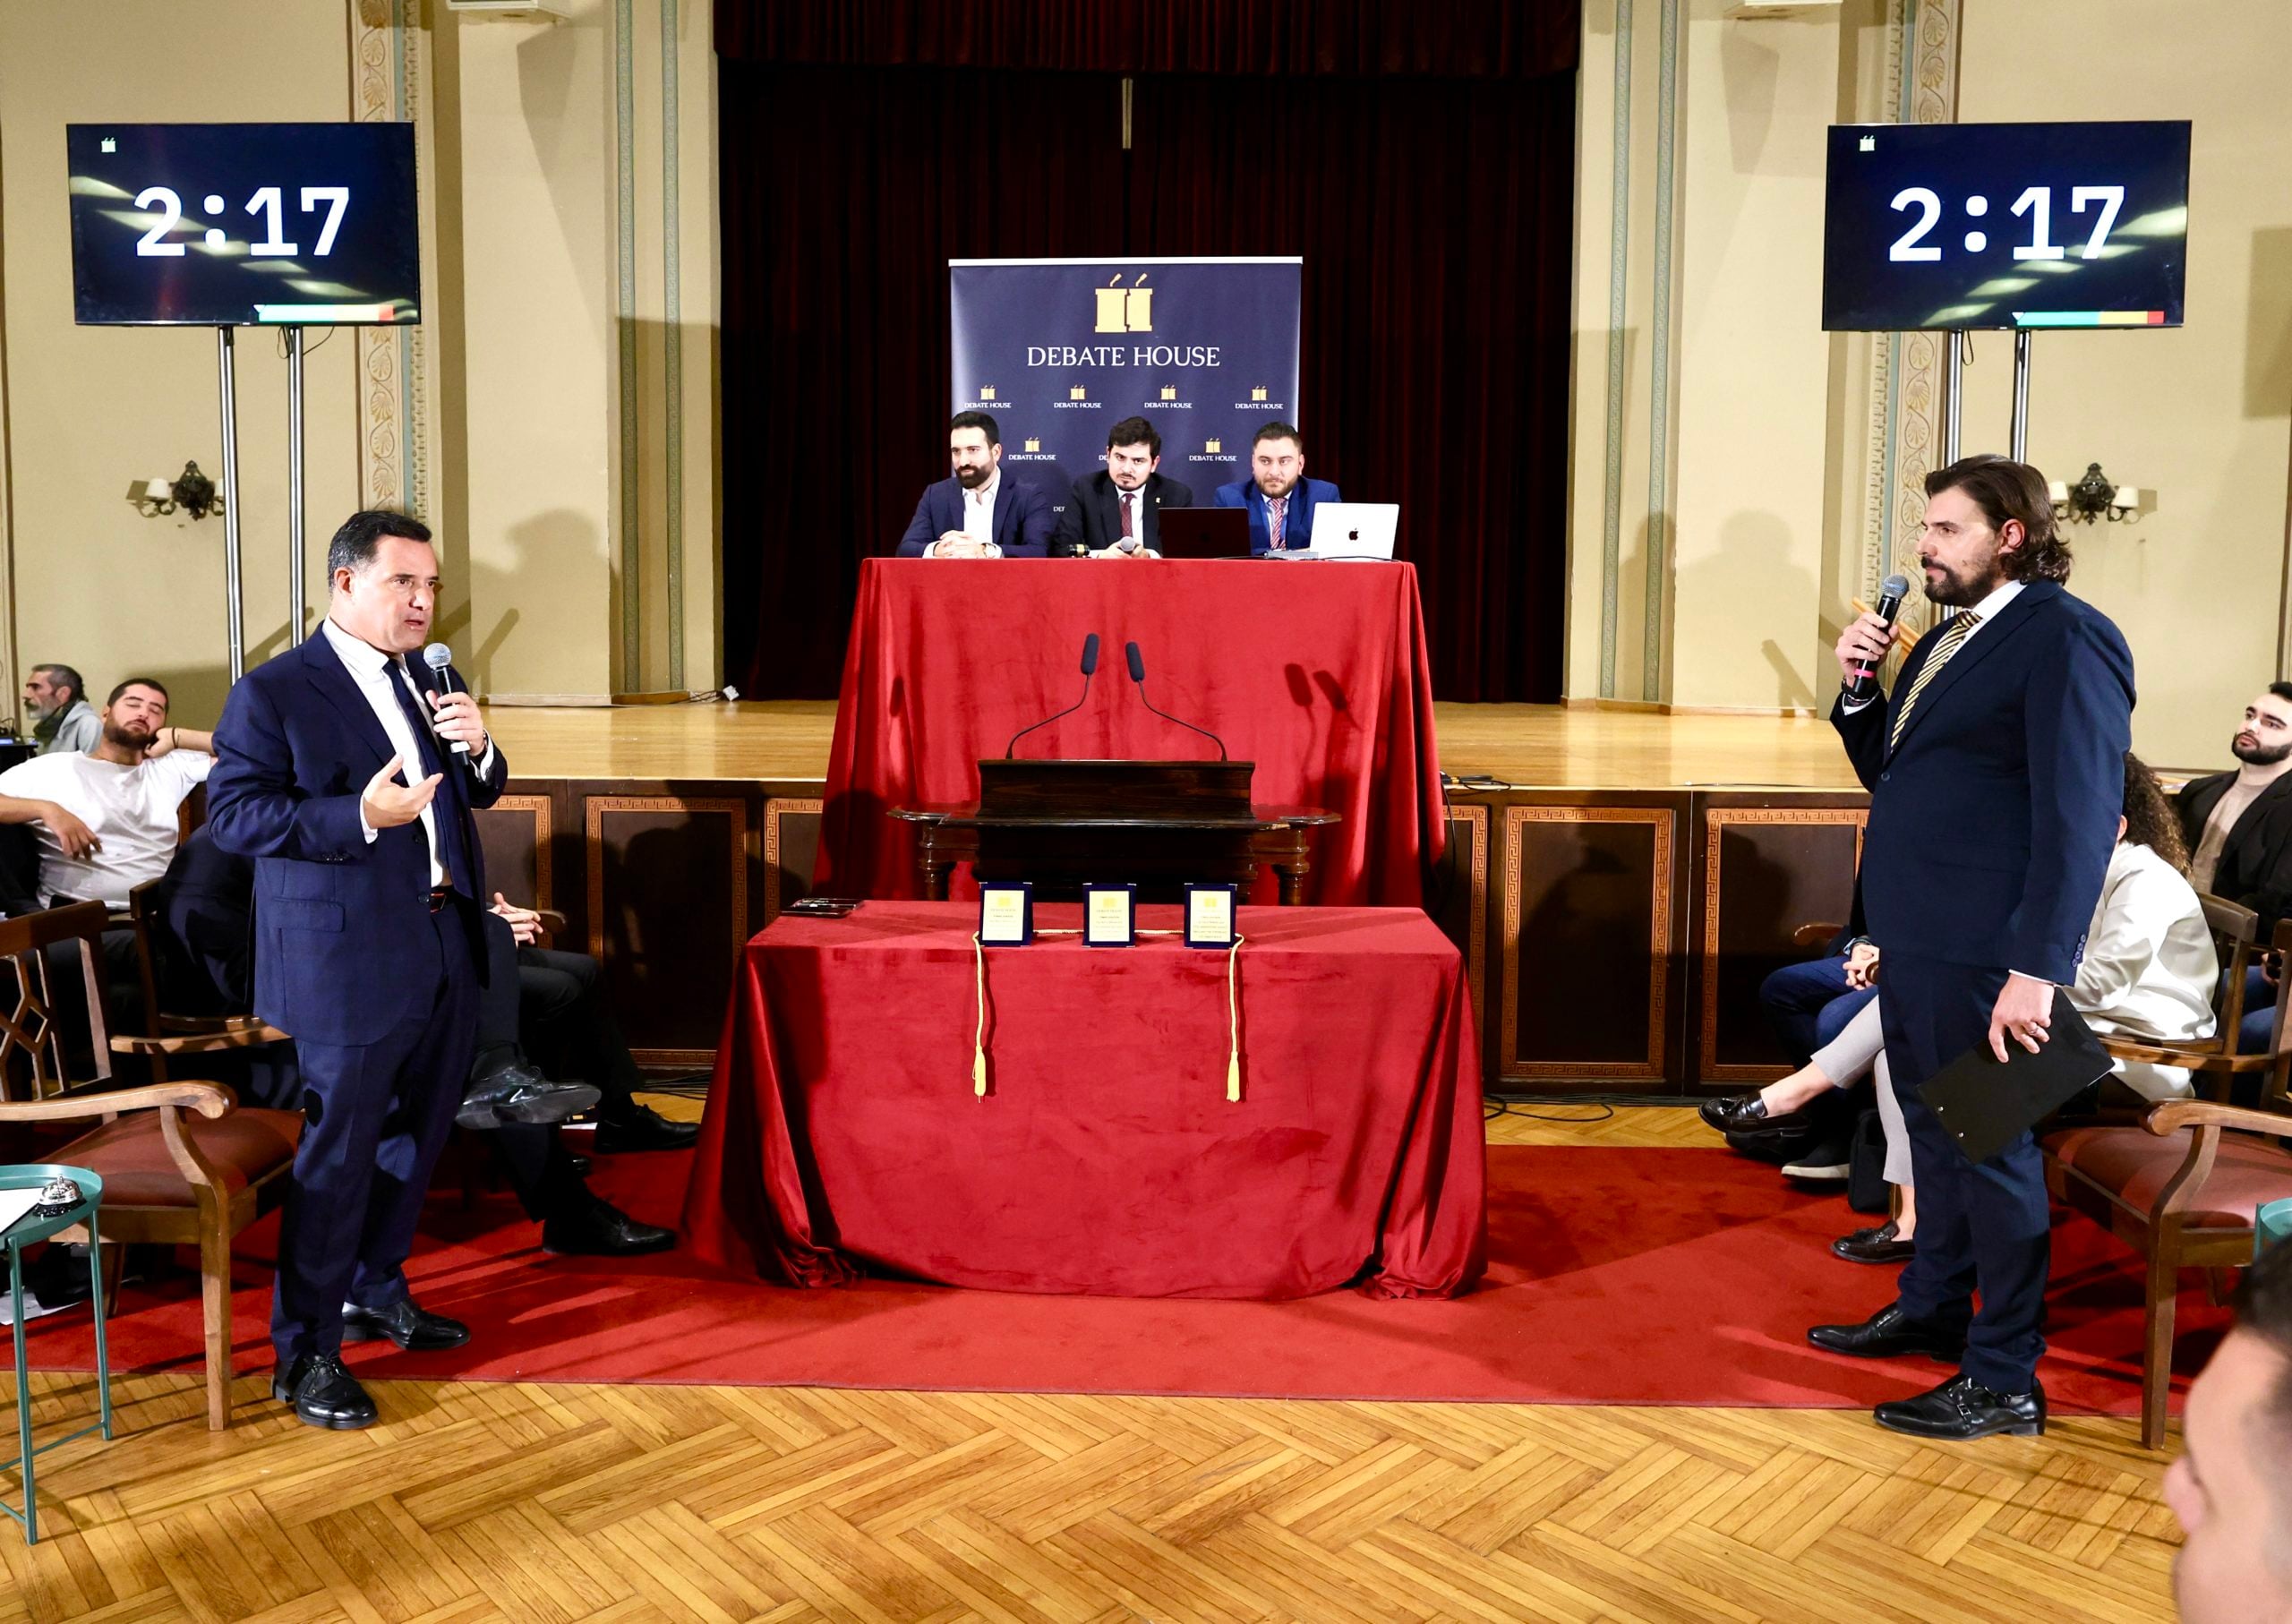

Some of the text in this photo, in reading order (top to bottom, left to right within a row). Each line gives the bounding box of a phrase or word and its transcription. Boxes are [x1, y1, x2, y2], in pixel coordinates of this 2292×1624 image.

[133, 186, 351, 257] 2:17
[1888, 185, 2125, 262] 2:17
[1027, 346, 1220, 367] DEBATE HOUSE
